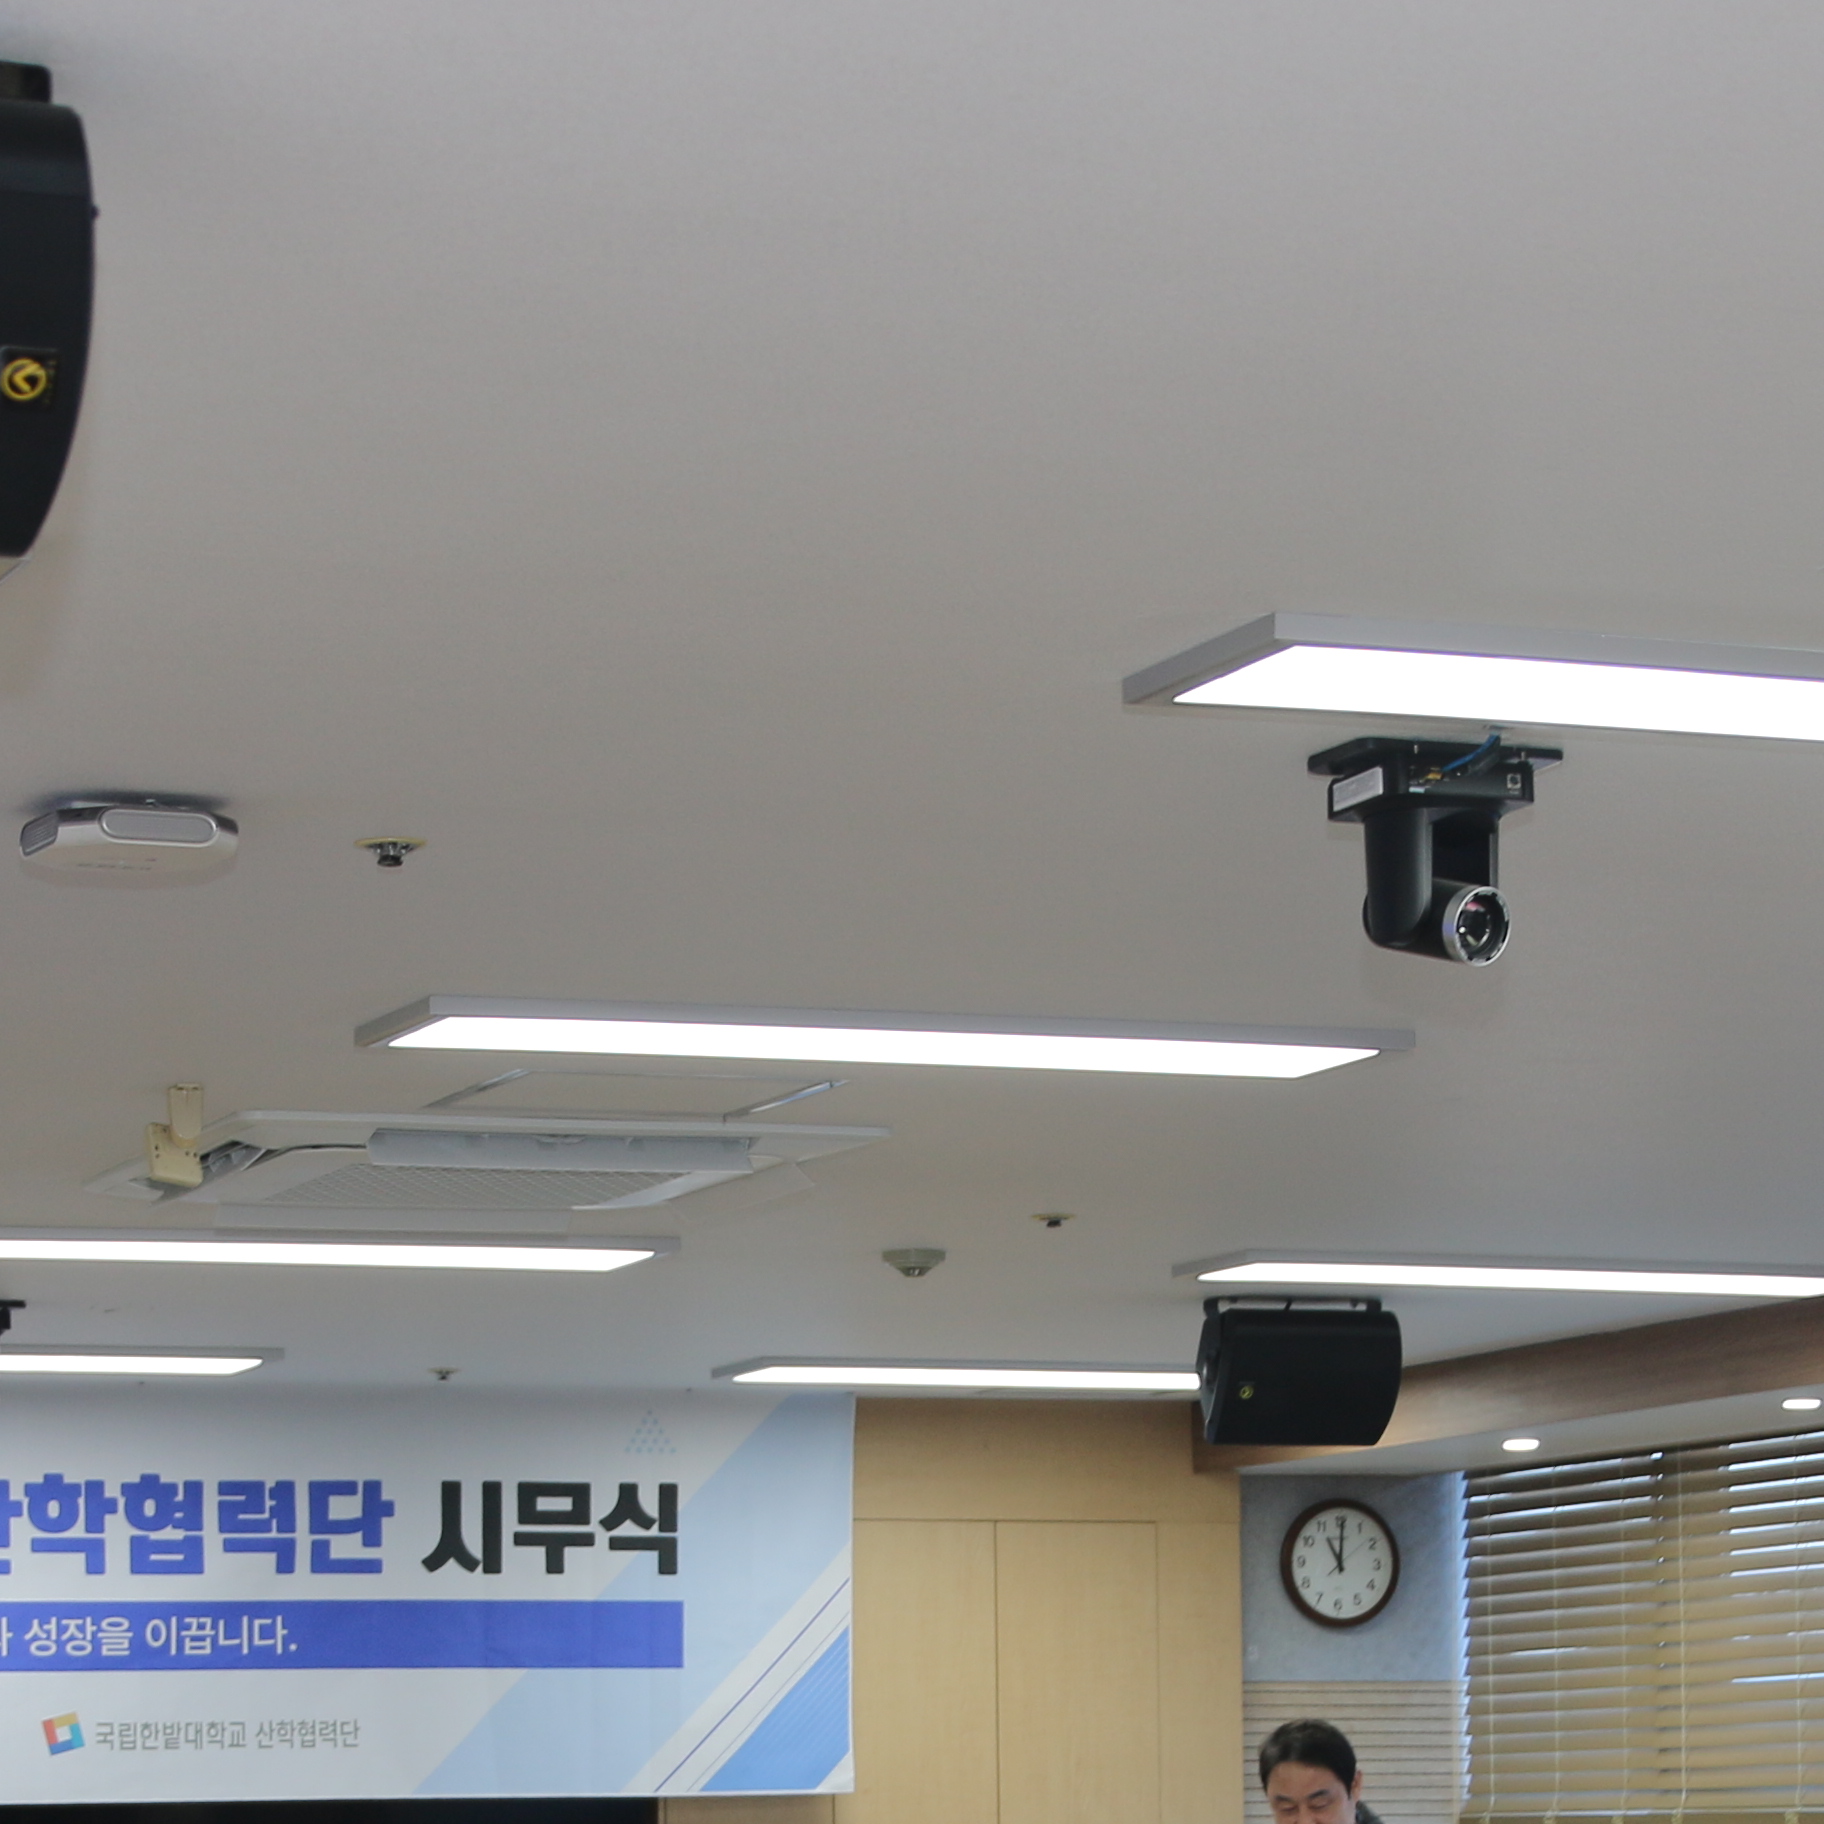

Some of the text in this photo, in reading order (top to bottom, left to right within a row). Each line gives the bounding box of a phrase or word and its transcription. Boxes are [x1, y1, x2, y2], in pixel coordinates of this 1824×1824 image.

[421, 1480, 679, 1575] 시무식
[24, 1617, 134, 1657] 성장을
[95, 1718, 360, 1752] 국립한밭대학교 산학협력단
